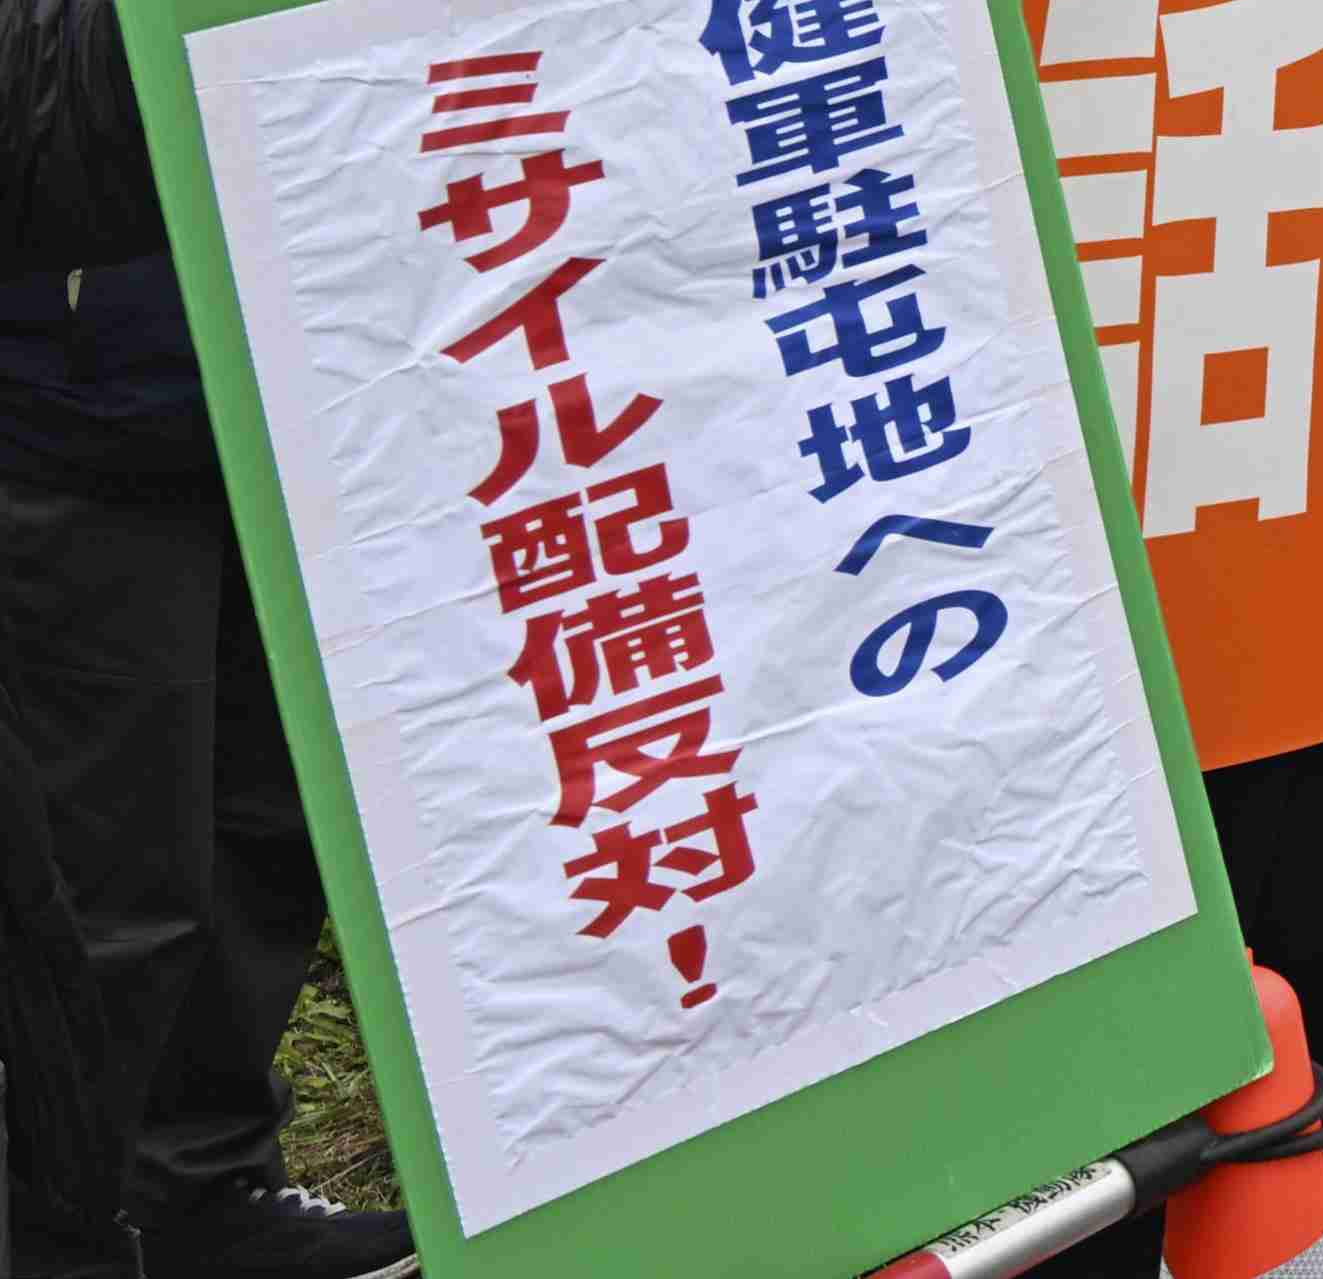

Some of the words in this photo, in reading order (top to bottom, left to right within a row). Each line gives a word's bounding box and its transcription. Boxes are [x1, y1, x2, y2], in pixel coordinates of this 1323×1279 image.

[416, 50, 759, 1010] ミサイル配備反対！
